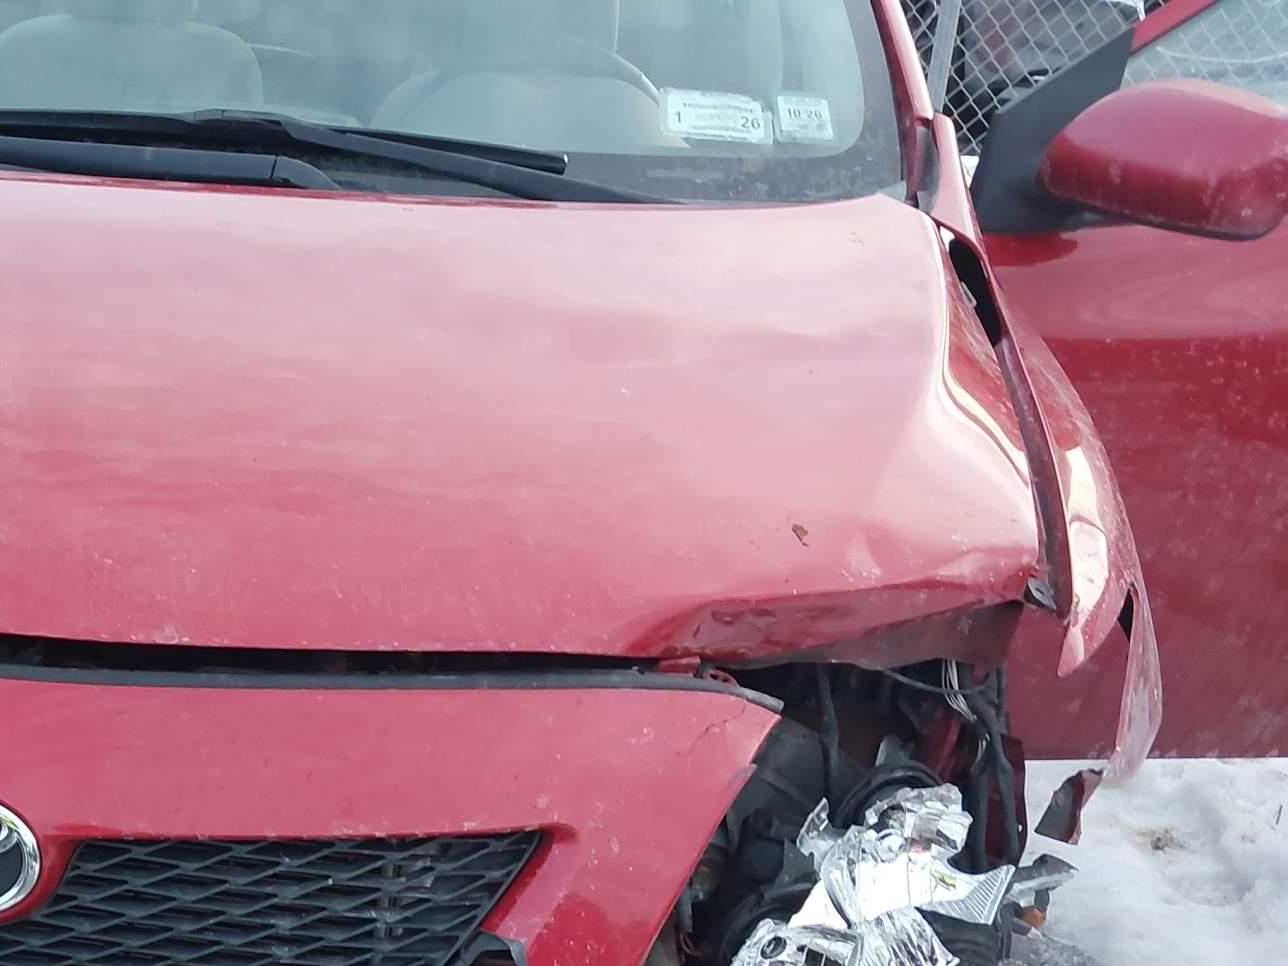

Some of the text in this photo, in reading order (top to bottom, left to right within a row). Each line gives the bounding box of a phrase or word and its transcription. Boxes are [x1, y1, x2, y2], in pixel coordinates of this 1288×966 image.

[787, 107, 801, 118] 10
[674, 111, 681, 123] 1
[740, 115, 761, 129] 26
